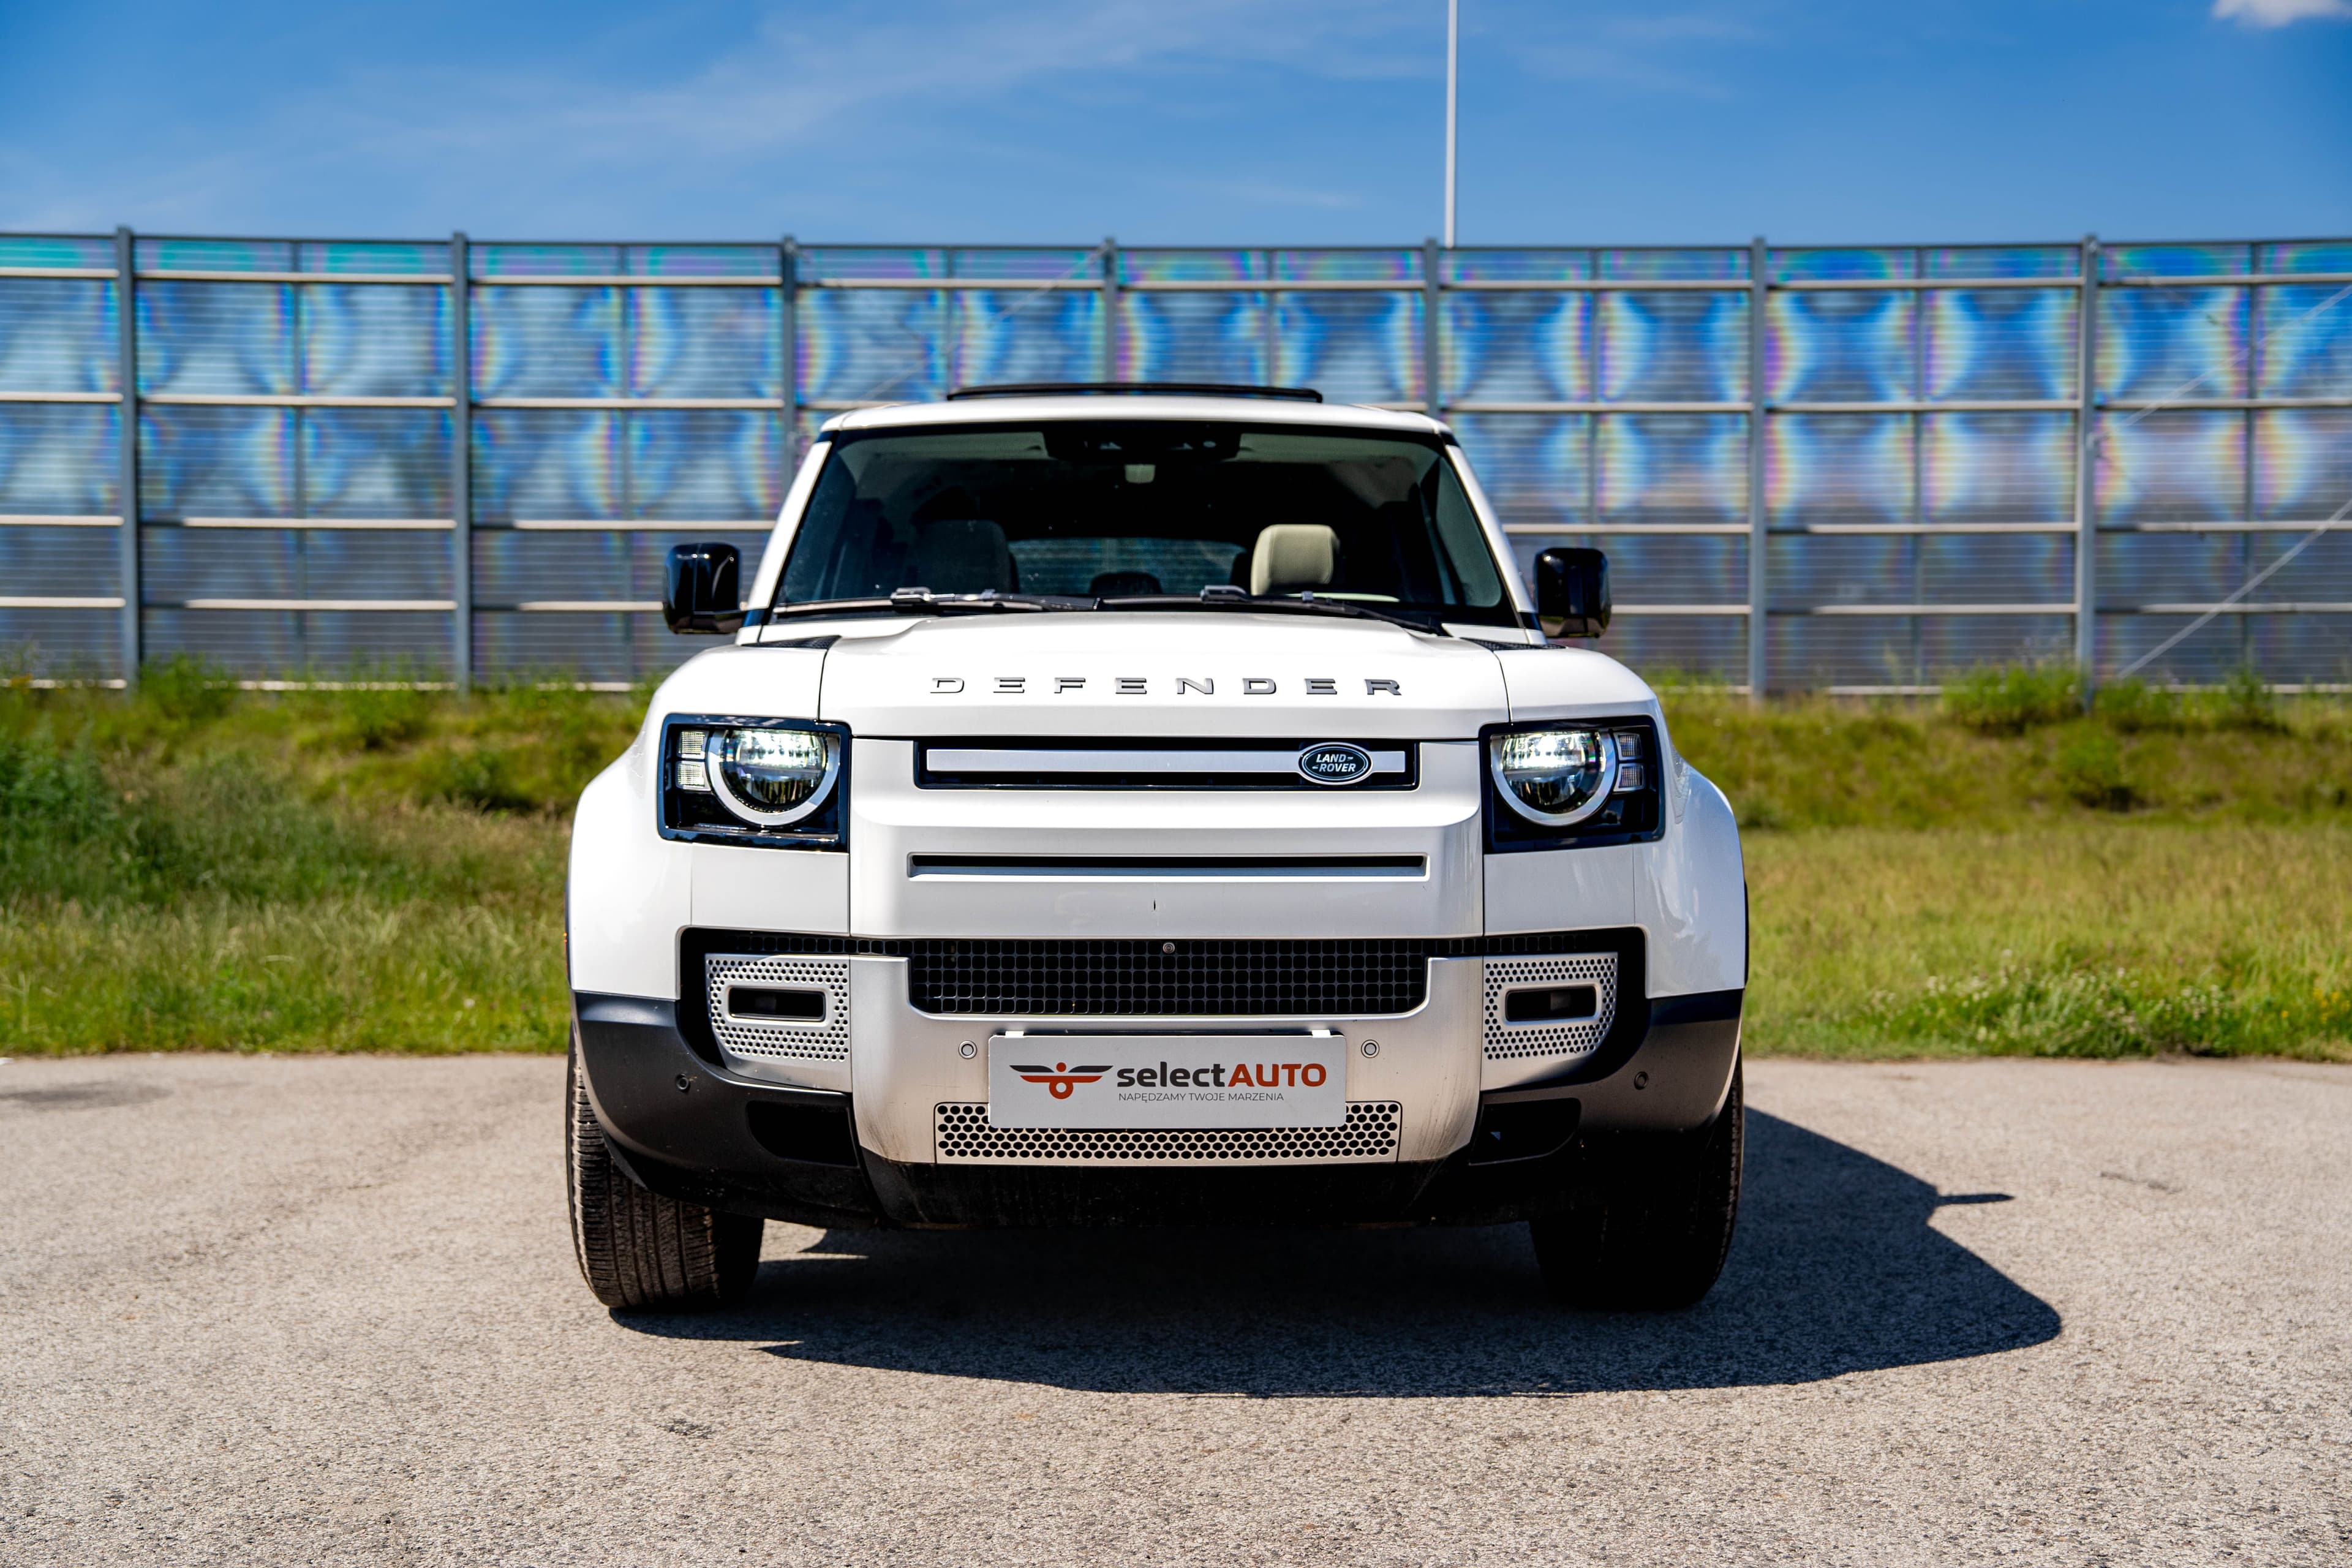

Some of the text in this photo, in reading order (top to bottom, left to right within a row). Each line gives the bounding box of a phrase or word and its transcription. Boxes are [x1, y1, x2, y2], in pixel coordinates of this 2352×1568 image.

[930, 677, 1402, 695] DEFENDER
[1117, 1061, 1327, 1087] selectAUTO
[1118, 1093, 1284, 1103] NAPĘDZAMY TWOJE MARZENIA
